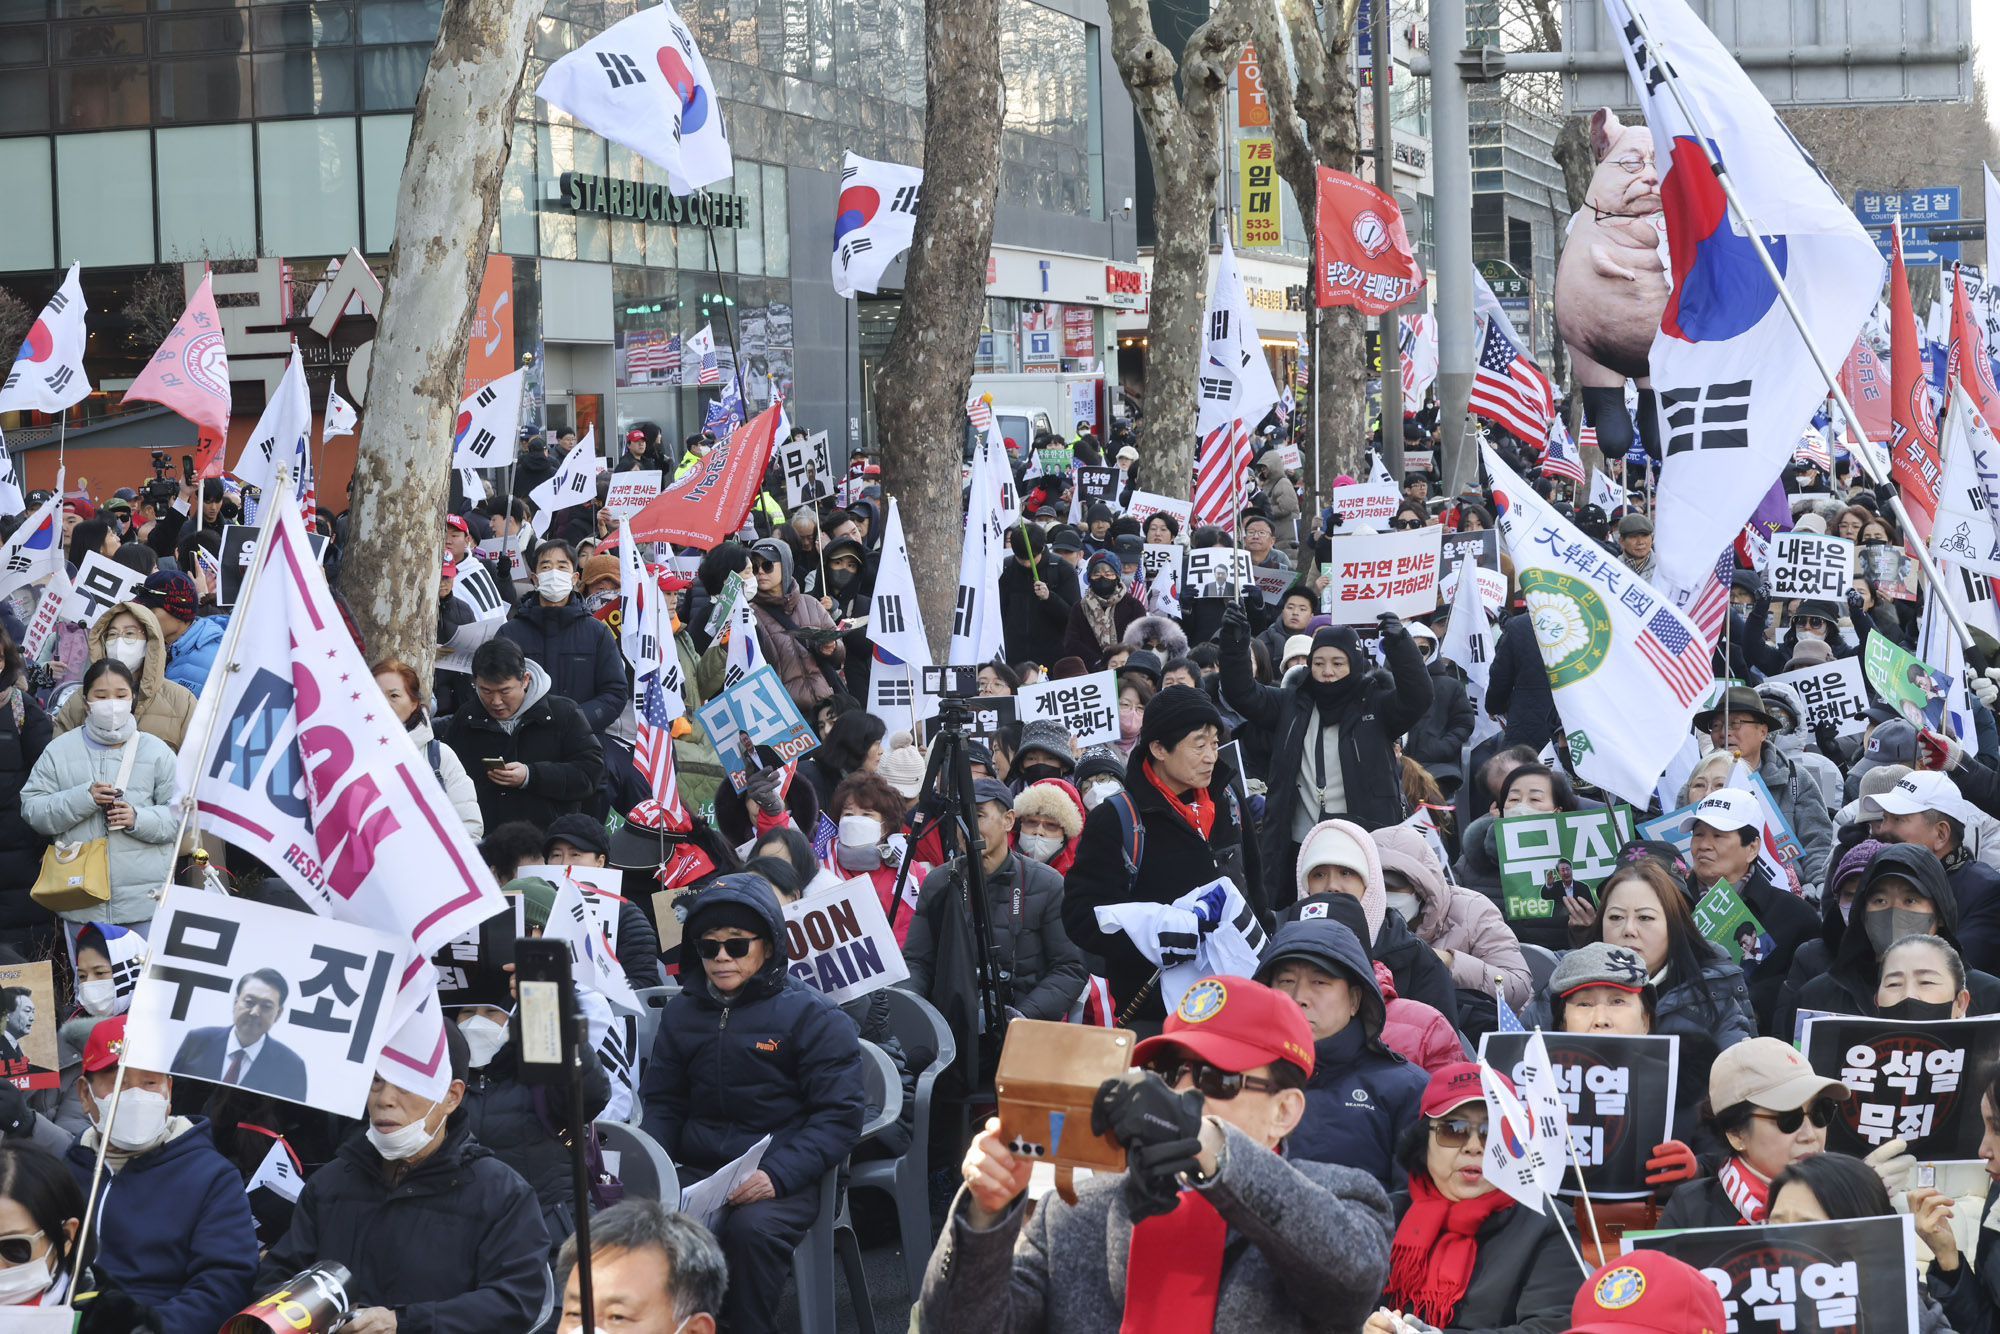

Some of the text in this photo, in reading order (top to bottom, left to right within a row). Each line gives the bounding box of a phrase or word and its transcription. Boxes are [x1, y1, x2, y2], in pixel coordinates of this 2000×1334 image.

[1247, 144, 1272, 159] 7층
[570, 172, 750, 229] STARBUCKS COFFEE
[1249, 166, 1272, 213] 임대
[1246, 219, 1274, 229] 533-
[1246, 231, 1279, 241] 9100
[634, 484, 657, 495] 판사는
[1082, 472, 1111, 485] 윤석열
[1338, 496, 1395, 508] 지귀연 판사는
[1341, 552, 1435, 579] 지귀연 판사는
[1777, 539, 1847, 568] 내란은
[1189, 554, 1252, 583] 무죄
[1534, 527, 1654, 617] 大韓民國
[1775, 567, 1847, 597] 없었다
[1341, 572, 1434, 600] 공소기각하라!
[1035, 684, 1102, 717] 계엄은
[700, 671, 800, 760] 무죄
[774, 732, 816, 760] Yoon
[1502, 810, 1632, 886] 무죄
[1013, 887, 1021, 915] Canon
[1509, 897, 1549, 918] Free
[786, 899, 863, 961] OON
[788, 936, 886, 994] GAIN
[150, 909, 395, 1064] 무죄
[1841, 1045, 1965, 1095] 윤석열
[1345, 1102, 1375, 1111] BEANPOLE
[1857, 1103, 1935, 1145] 무죄
[1700, 1262, 1859, 1333] 윤석열
